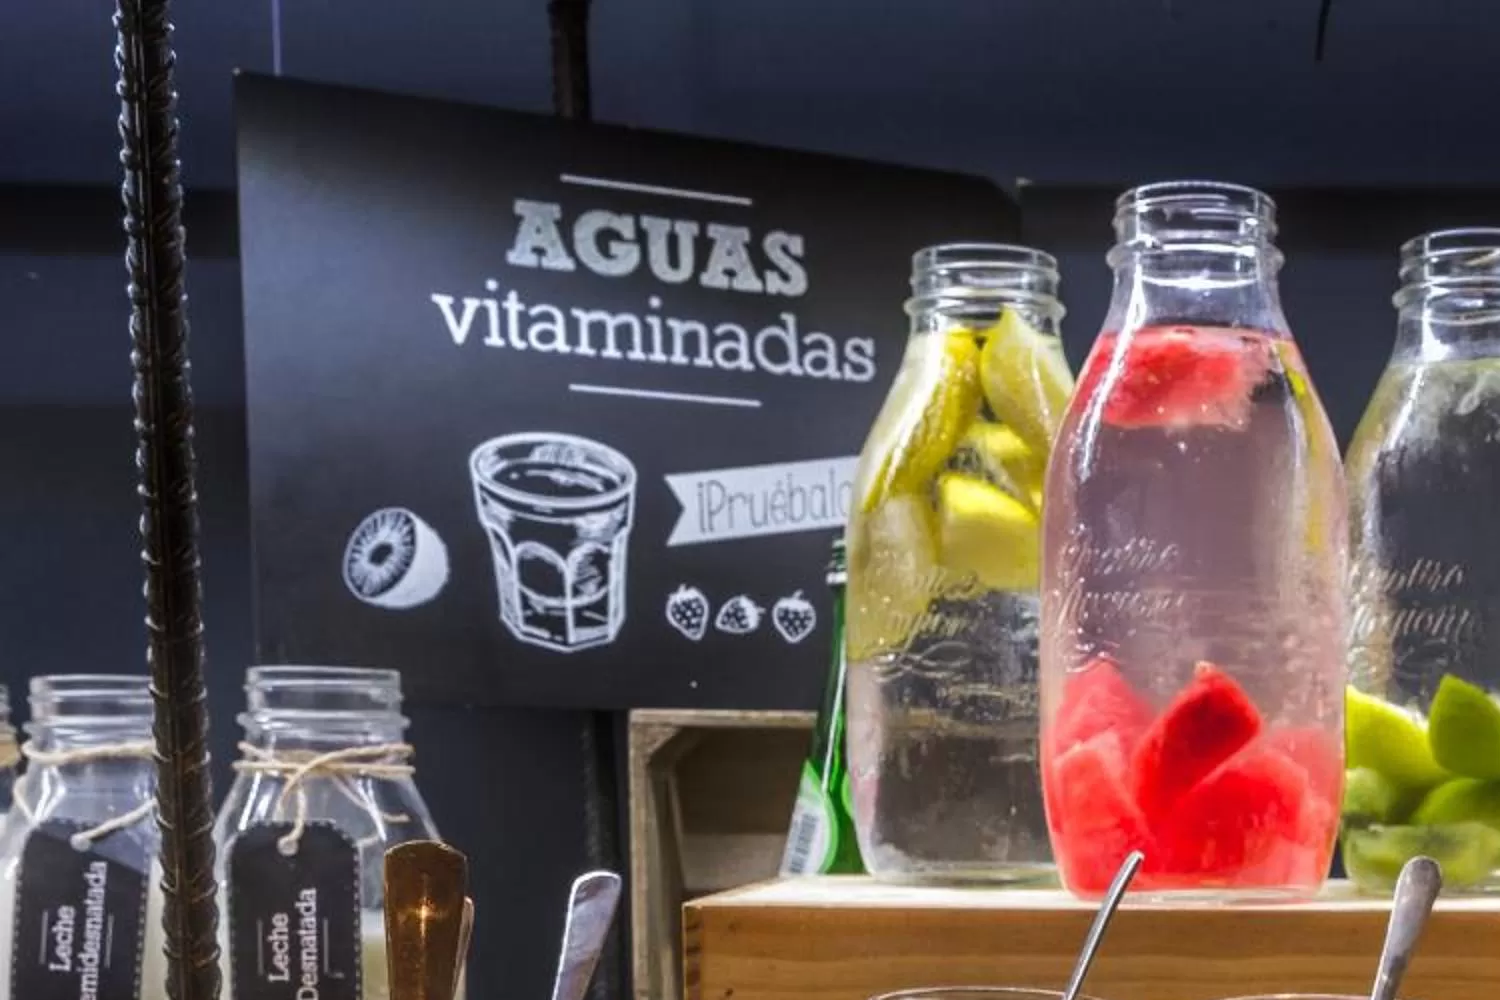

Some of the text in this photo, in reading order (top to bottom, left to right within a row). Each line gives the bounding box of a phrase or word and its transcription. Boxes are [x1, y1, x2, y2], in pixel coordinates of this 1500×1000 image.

[506, 199, 808, 297] AGUAS
[431, 278, 877, 382] vitaminadas
[49, 905, 77, 972] Leche
[268, 911, 291, 983] Leche
